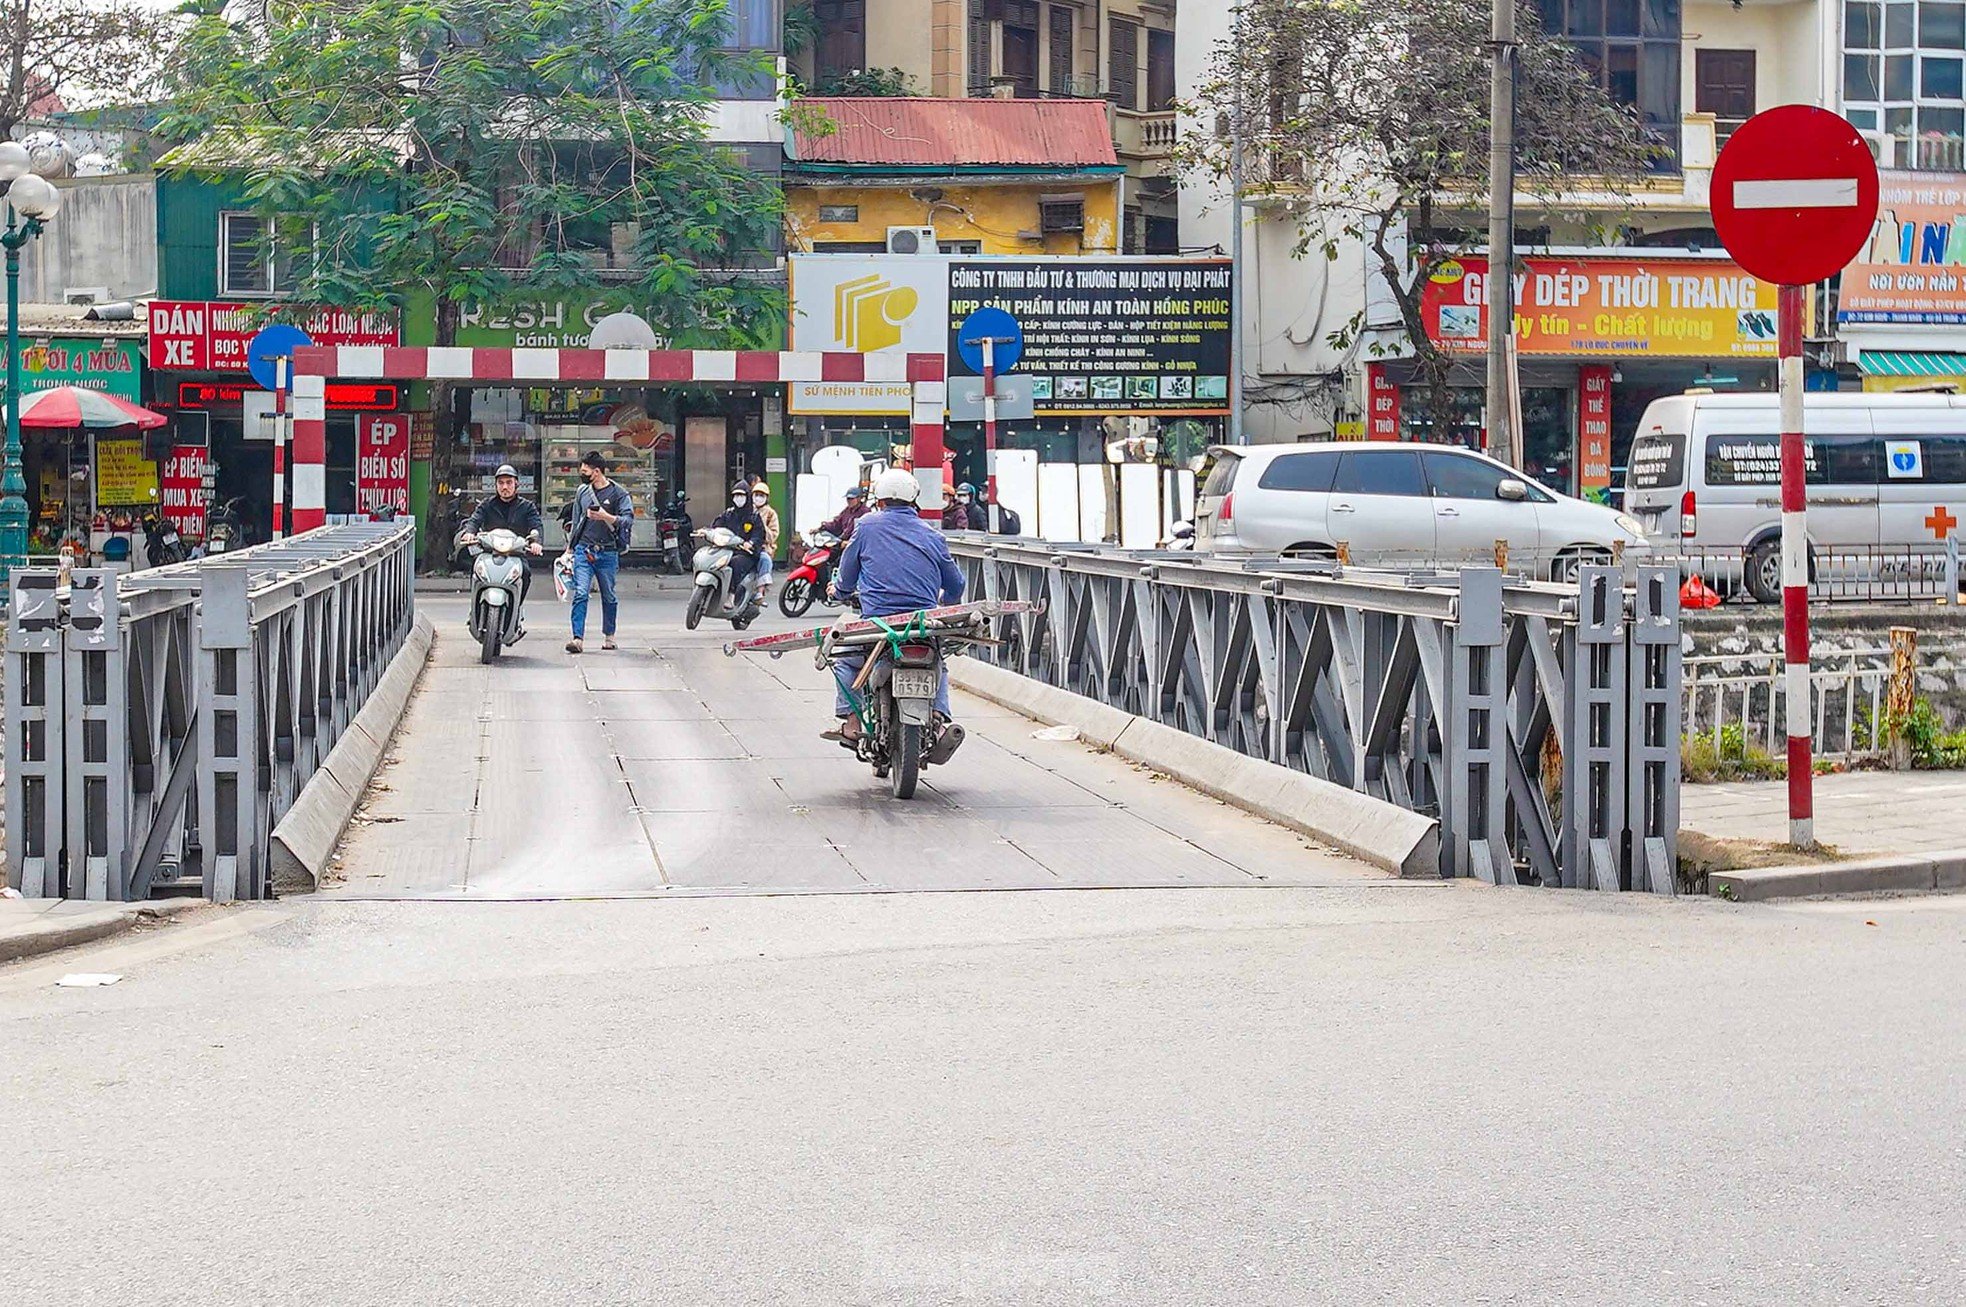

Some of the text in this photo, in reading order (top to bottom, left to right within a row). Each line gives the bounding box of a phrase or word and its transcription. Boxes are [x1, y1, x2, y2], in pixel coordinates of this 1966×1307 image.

[952, 265, 1231, 292] CÔNG TY TNHH ĐẦU TƯ & THƯƠNG MẠI DỊCH VỤ ĐẠI PHÁT
[1464, 267, 1757, 308] GIY DÉP THỜI TRANG
[437, 301, 563, 329] RESH
[951, 300, 980, 314] NPP
[1014, 295, 1054, 315] PHẨM
[1057, 298, 1089, 315] KÍNH
[1092, 300, 1112, 315] AN
[1115, 298, 1150, 315] TOÀN
[1153, 295, 1190, 315] HỒNG
[1193, 298, 1229, 315] PHÚC
[153, 304, 203, 335] DÁN
[1043, 321, 1061, 330] KÍNH
[1540, 313, 1570, 336] tín
[1594, 312, 1647, 336] Chất
[1653, 314, 1714, 342] lượng
[215, 339, 239, 358] BỌC
[515, 332, 557, 347] bánh
[562, 332, 592, 347] tươ
[21, 346, 69, 372] TƠI
[72, 351, 83, 373] 4
[164, 340, 195, 365] XE
[804, 384, 819, 396] SỨ
[823, 384, 856, 399] MỆNH
[887, 387, 911, 397] PHO
[1375, 376, 1393, 390] GI
[371, 418, 397, 446] ÉP
[1586, 421, 1606, 434] THAO
[361, 447, 407, 479] BIỂN SỐ
[163, 488, 187, 508] MUA
[190, 489, 203, 507] XE
[898, 683, 929, 696] 0579
